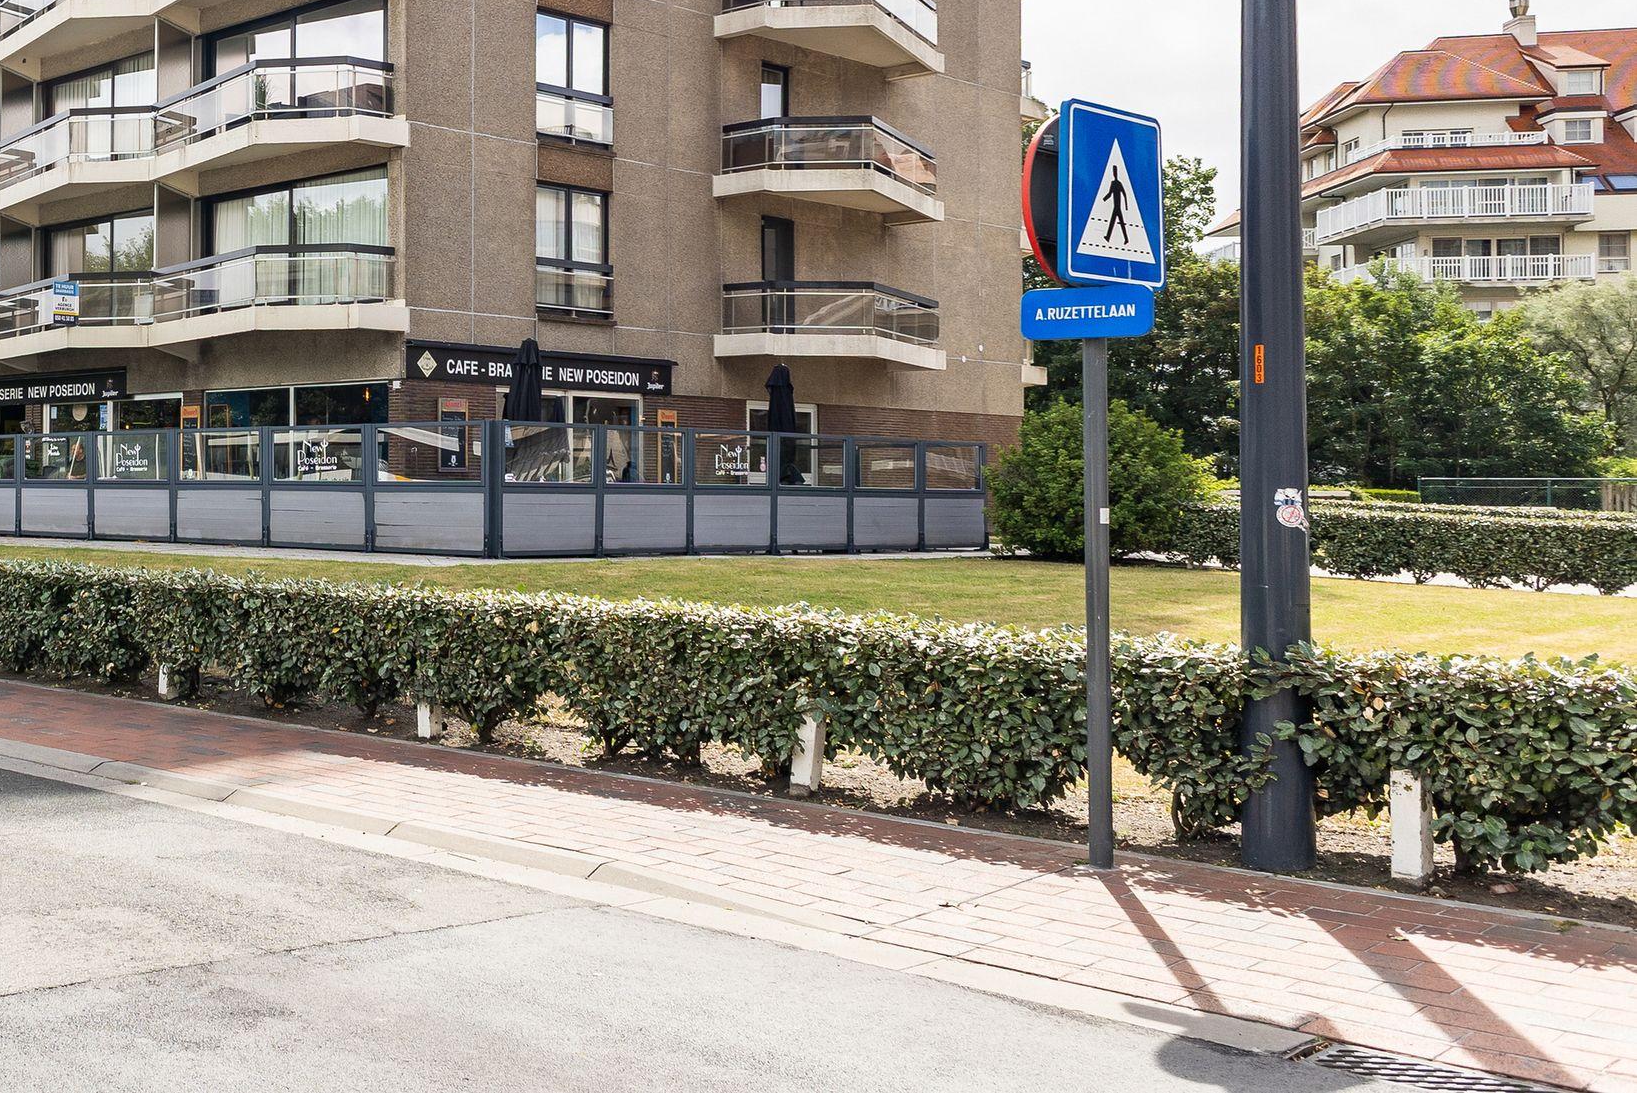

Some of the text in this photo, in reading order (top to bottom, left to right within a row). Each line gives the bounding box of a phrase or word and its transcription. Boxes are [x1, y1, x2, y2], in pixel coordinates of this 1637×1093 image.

[1035, 303, 1136, 321] A.RUZETTELAAN
[446, 359, 479, 376] CAFE
[488, 362, 553, 381] BRAIE
[559, 367, 584, 382] NEW
[586, 369, 639, 387] POSEIDON
[27, 385, 48, 399] NEW
[49, 382, 96, 397] POSEIDON
[120, 443, 137, 455] New
[303, 439, 323, 453] New
[720, 444, 738, 457] New
[116, 449, 148, 467] Poseidon
[297, 446, 338, 465] Poseidon
[715, 451, 749, 470] Poseidon
